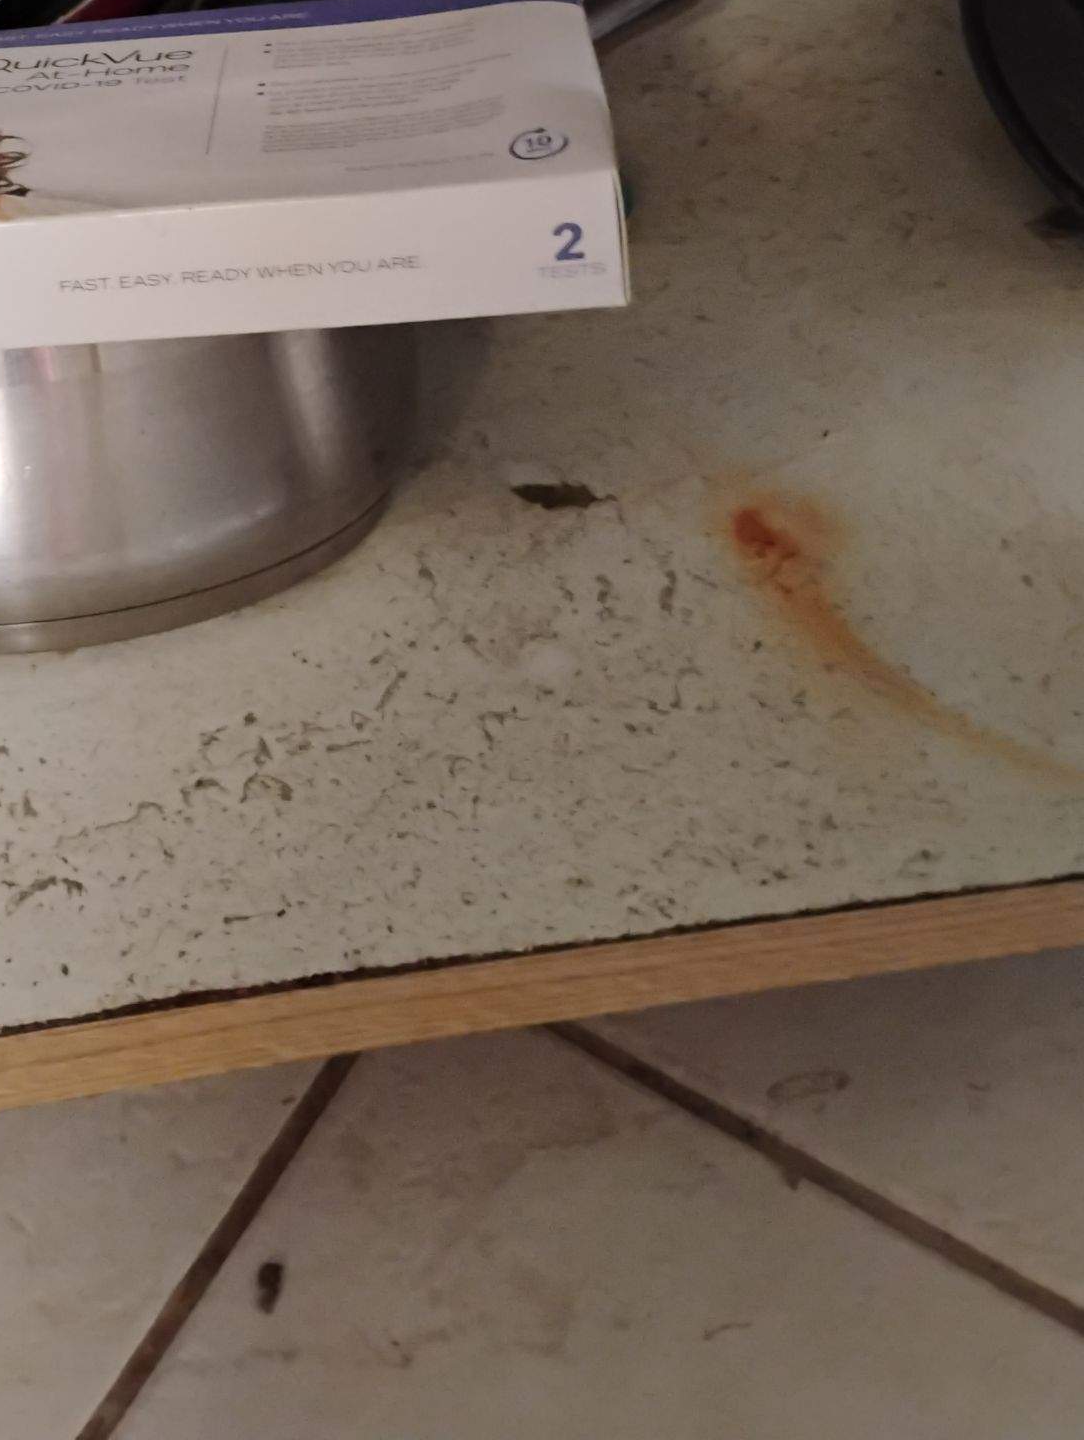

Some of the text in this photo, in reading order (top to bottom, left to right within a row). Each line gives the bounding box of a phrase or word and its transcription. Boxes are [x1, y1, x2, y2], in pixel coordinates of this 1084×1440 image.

[27, 64, 191, 81] At-Home
[552, 221, 586, 262] 2
[181, 266, 251, 285] READY
[256, 262, 324, 280] WHEN
[327, 259, 371, 274] YOU
